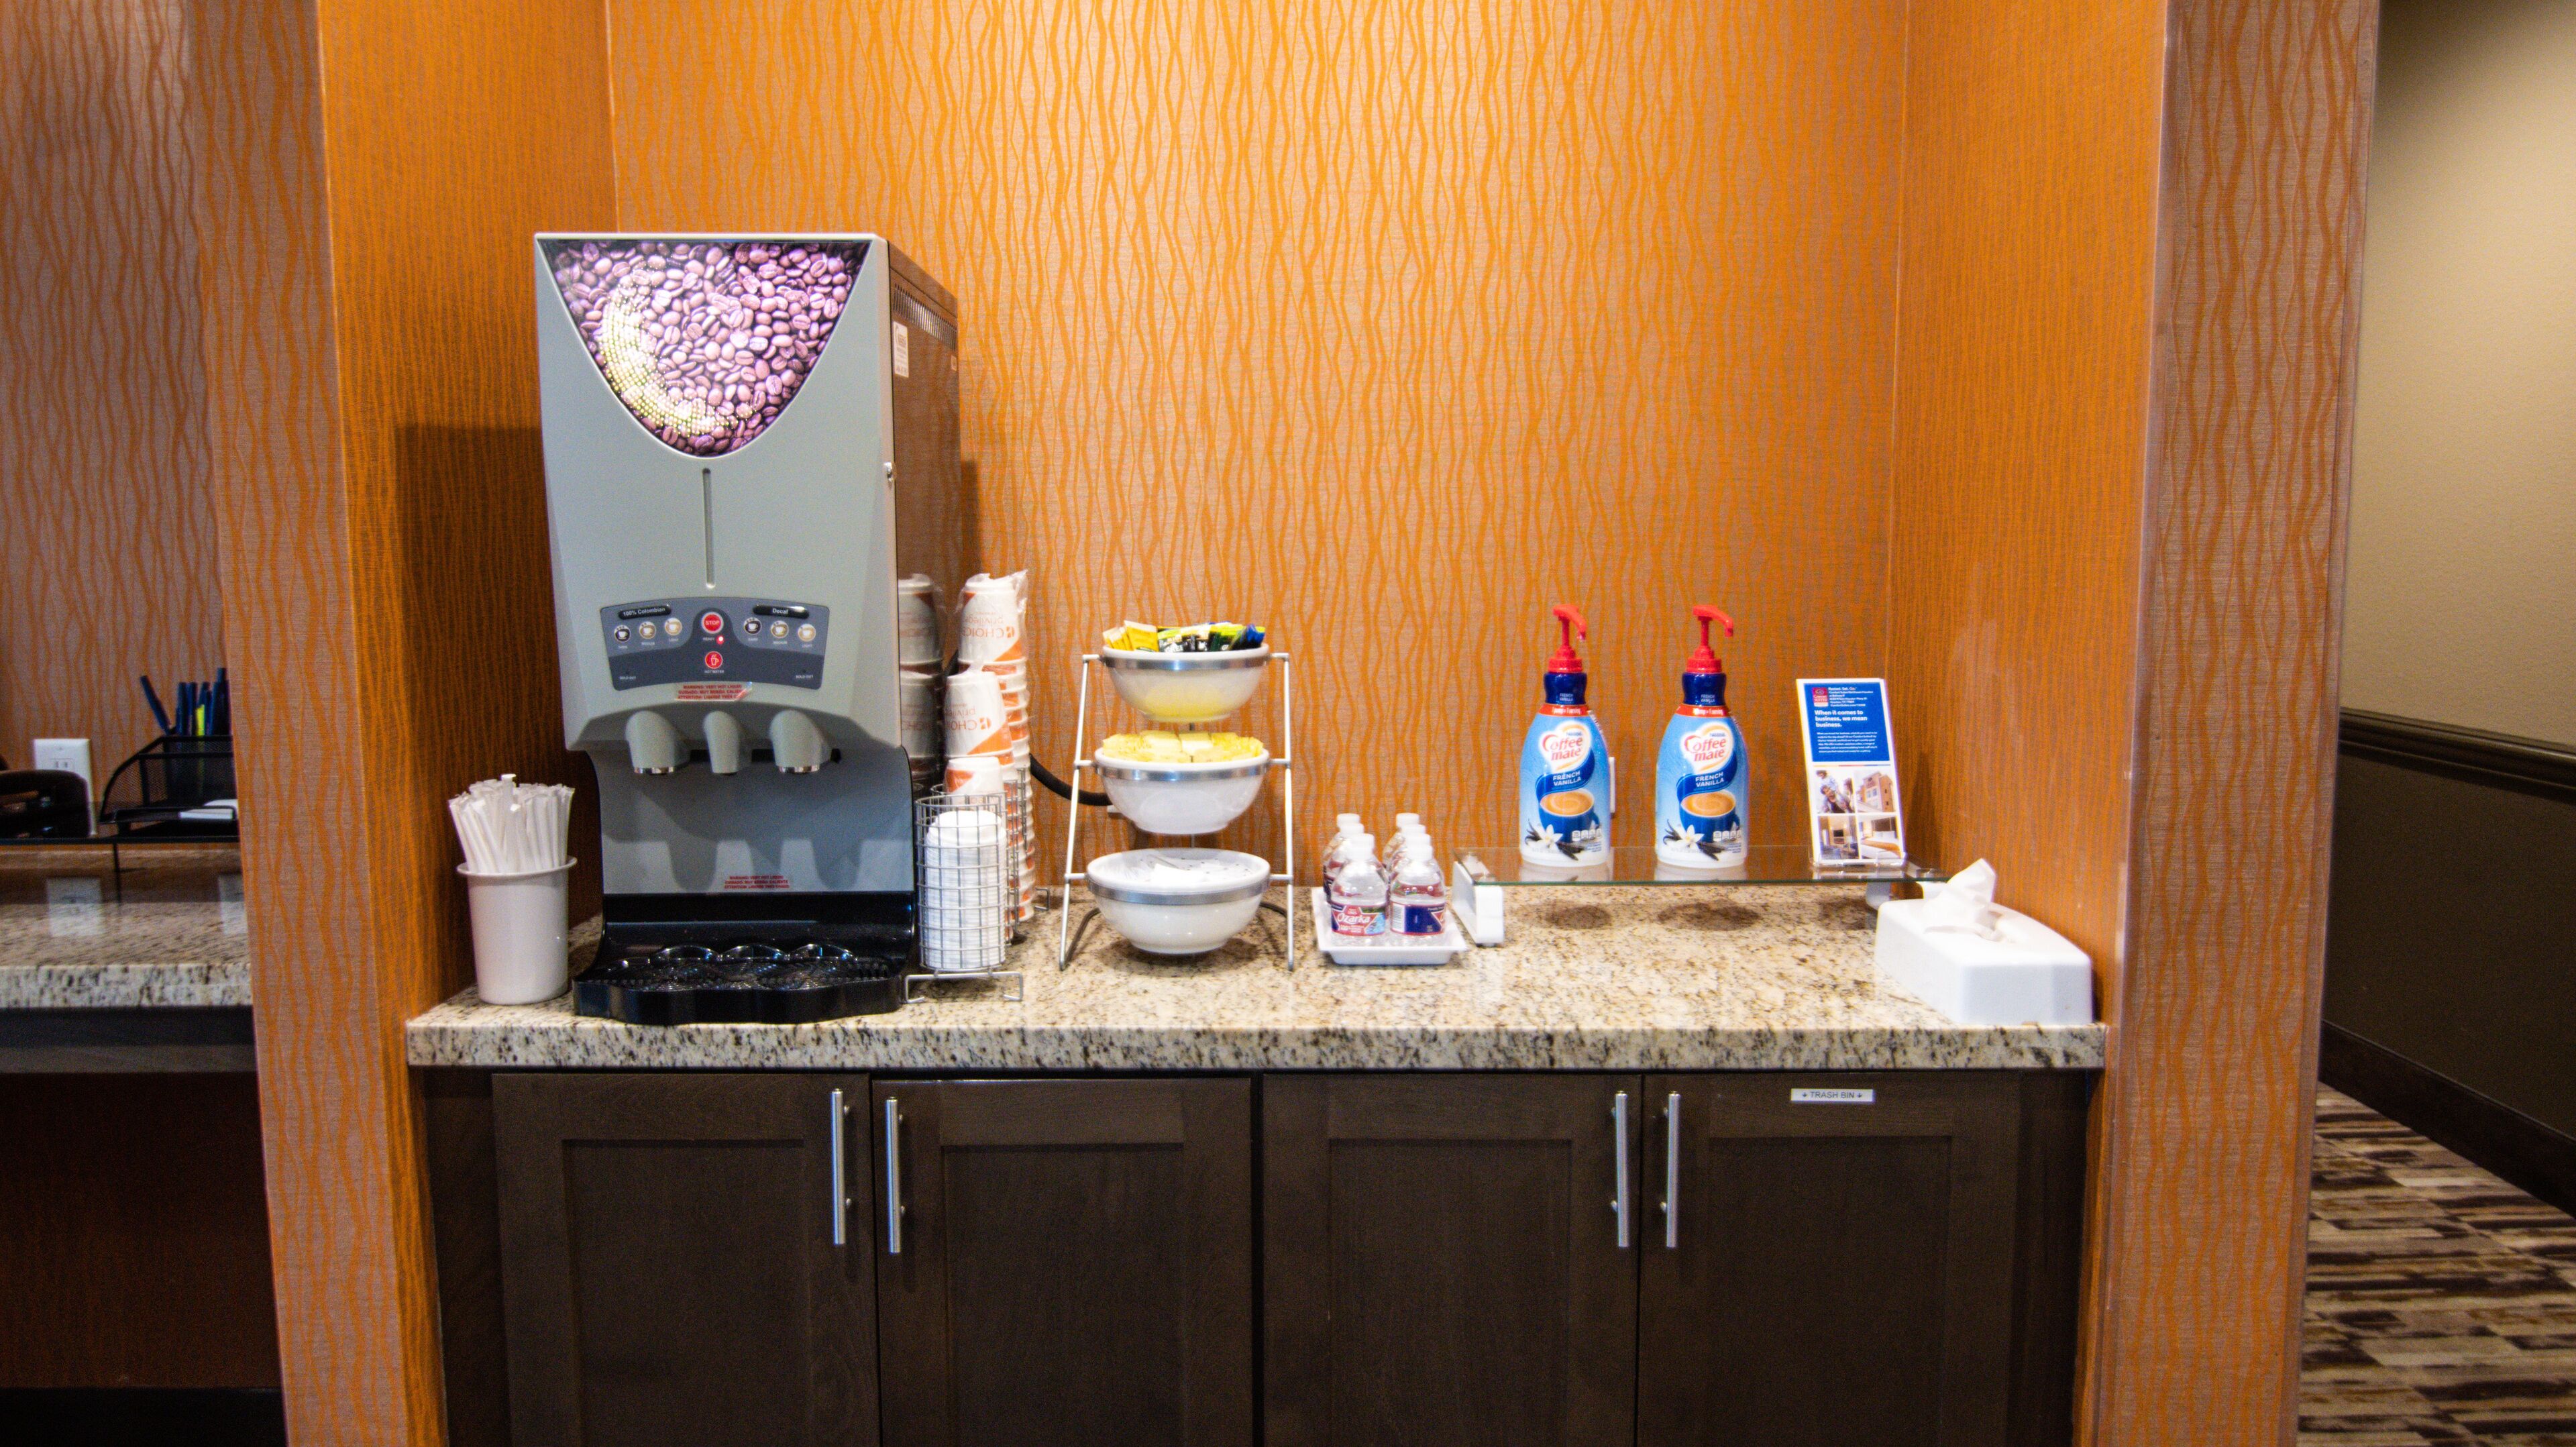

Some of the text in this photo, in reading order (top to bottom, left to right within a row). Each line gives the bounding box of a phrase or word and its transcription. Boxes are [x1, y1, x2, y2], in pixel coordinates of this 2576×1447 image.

[1542, 734, 1584, 752] Coffee
[1684, 735, 1727, 753] Coffee
[1551, 748, 1582, 761] mate
[1695, 749, 1725, 761] mate
[1553, 770, 1580, 781] FRENCH
[1554, 776, 1582, 786] VANILLA
[1695, 771, 1723, 782] FRENCH
[1696, 778, 1725, 788] VANILLA
[1337, 912, 1371, 924] Ozarka
